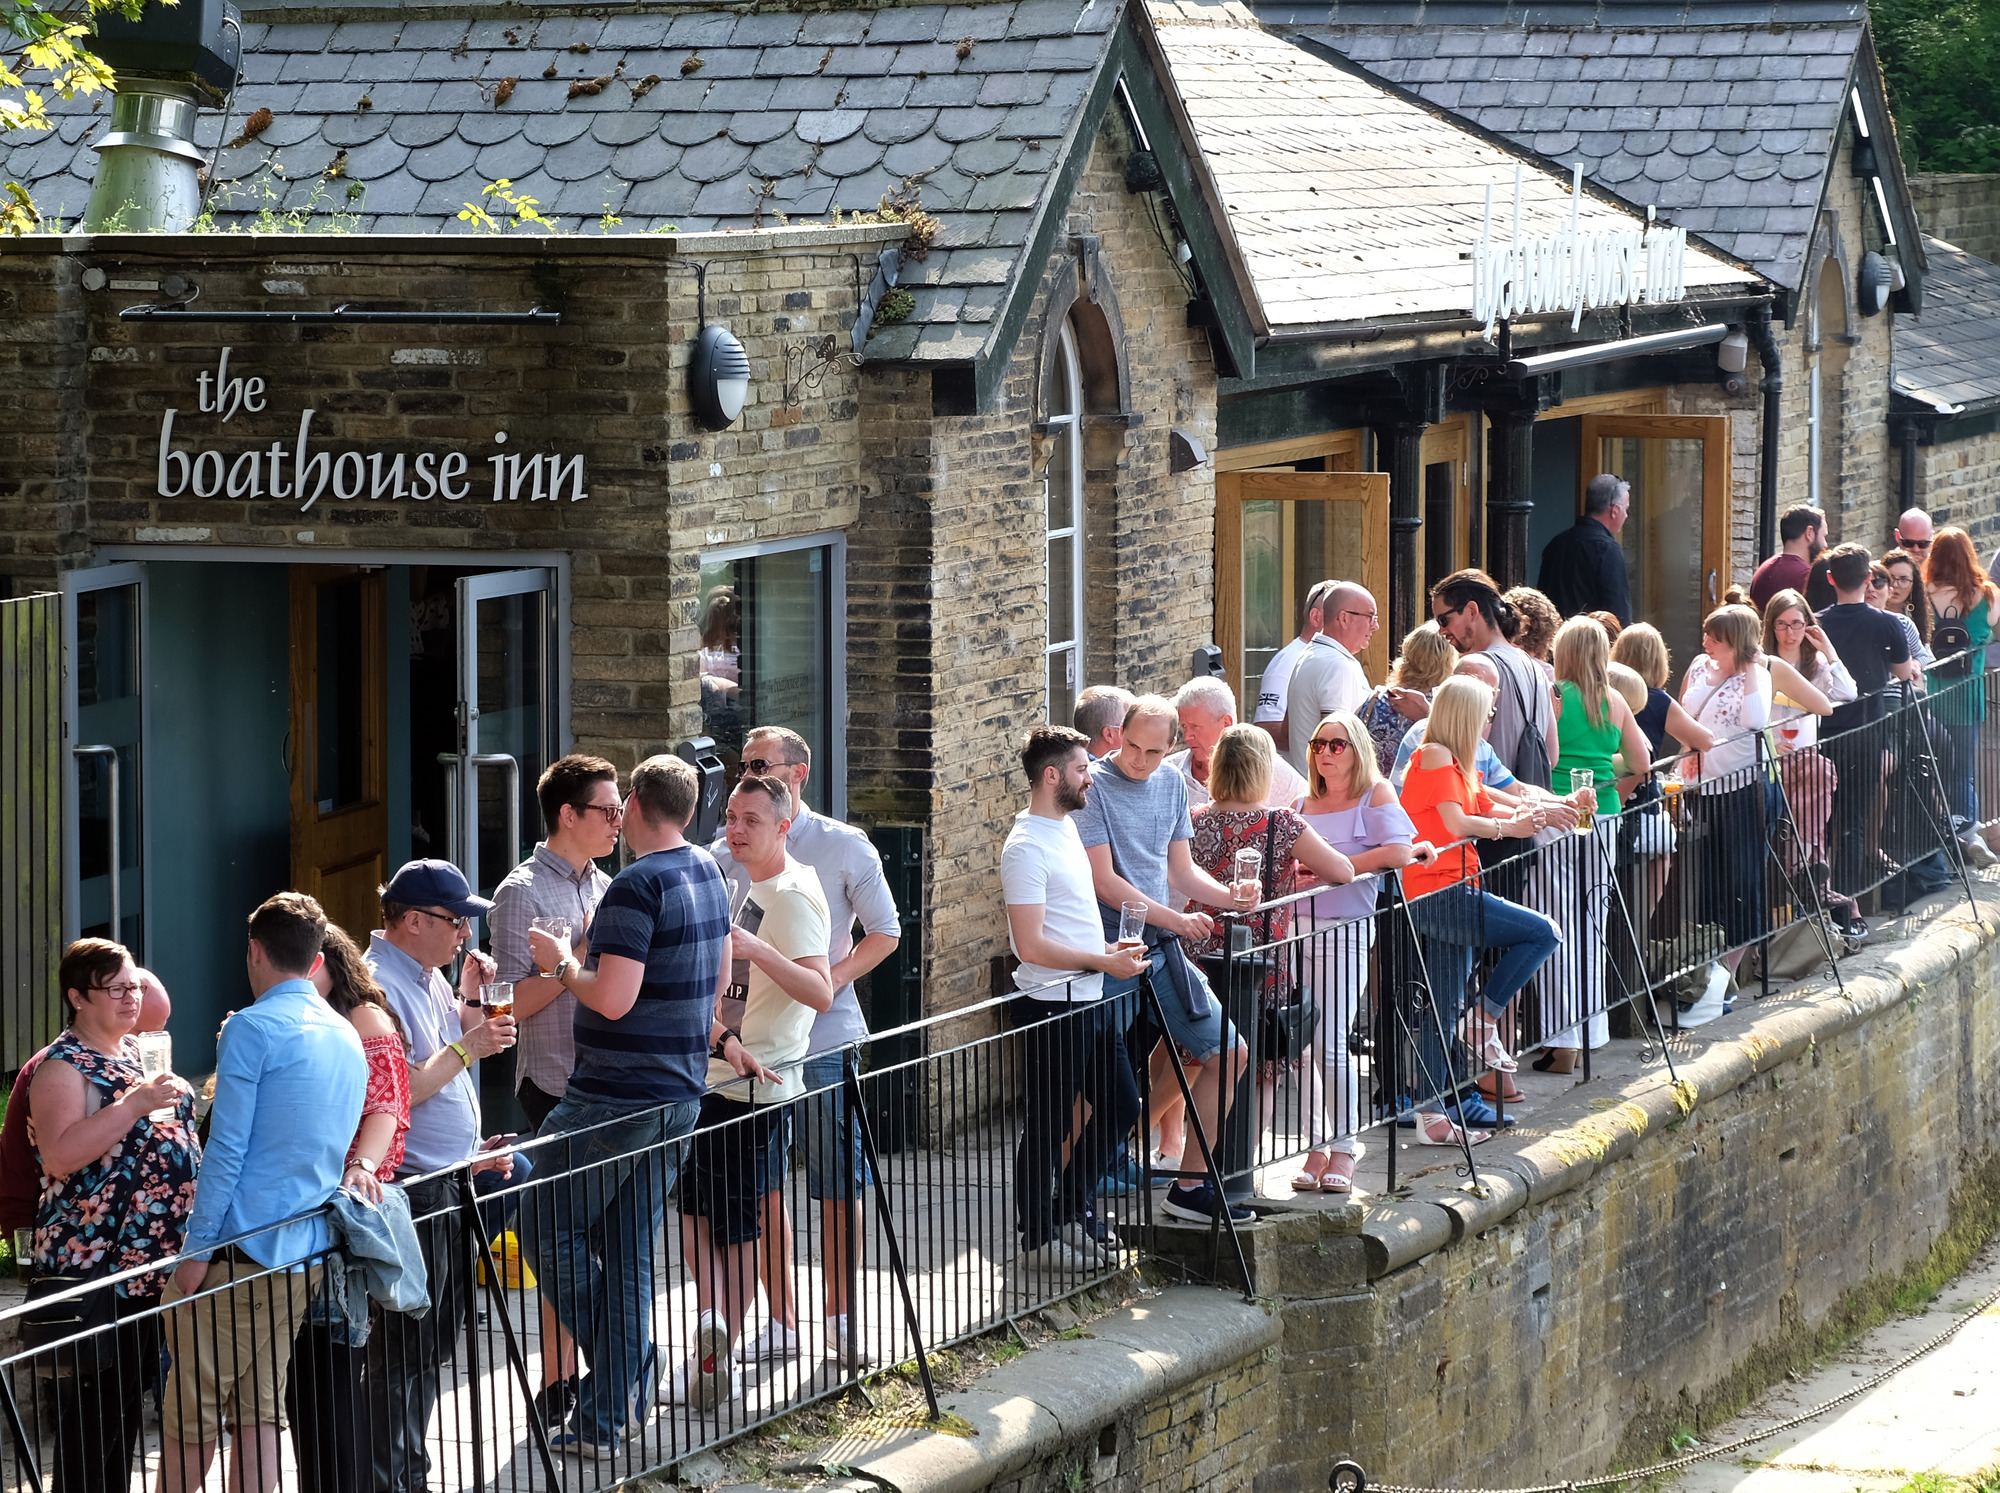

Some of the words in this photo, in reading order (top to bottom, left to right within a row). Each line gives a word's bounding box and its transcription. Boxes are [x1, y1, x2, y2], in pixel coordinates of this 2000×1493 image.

[197, 346, 266, 423] the
[157, 408, 470, 512] boathouse
[488, 431, 588, 502] inn
